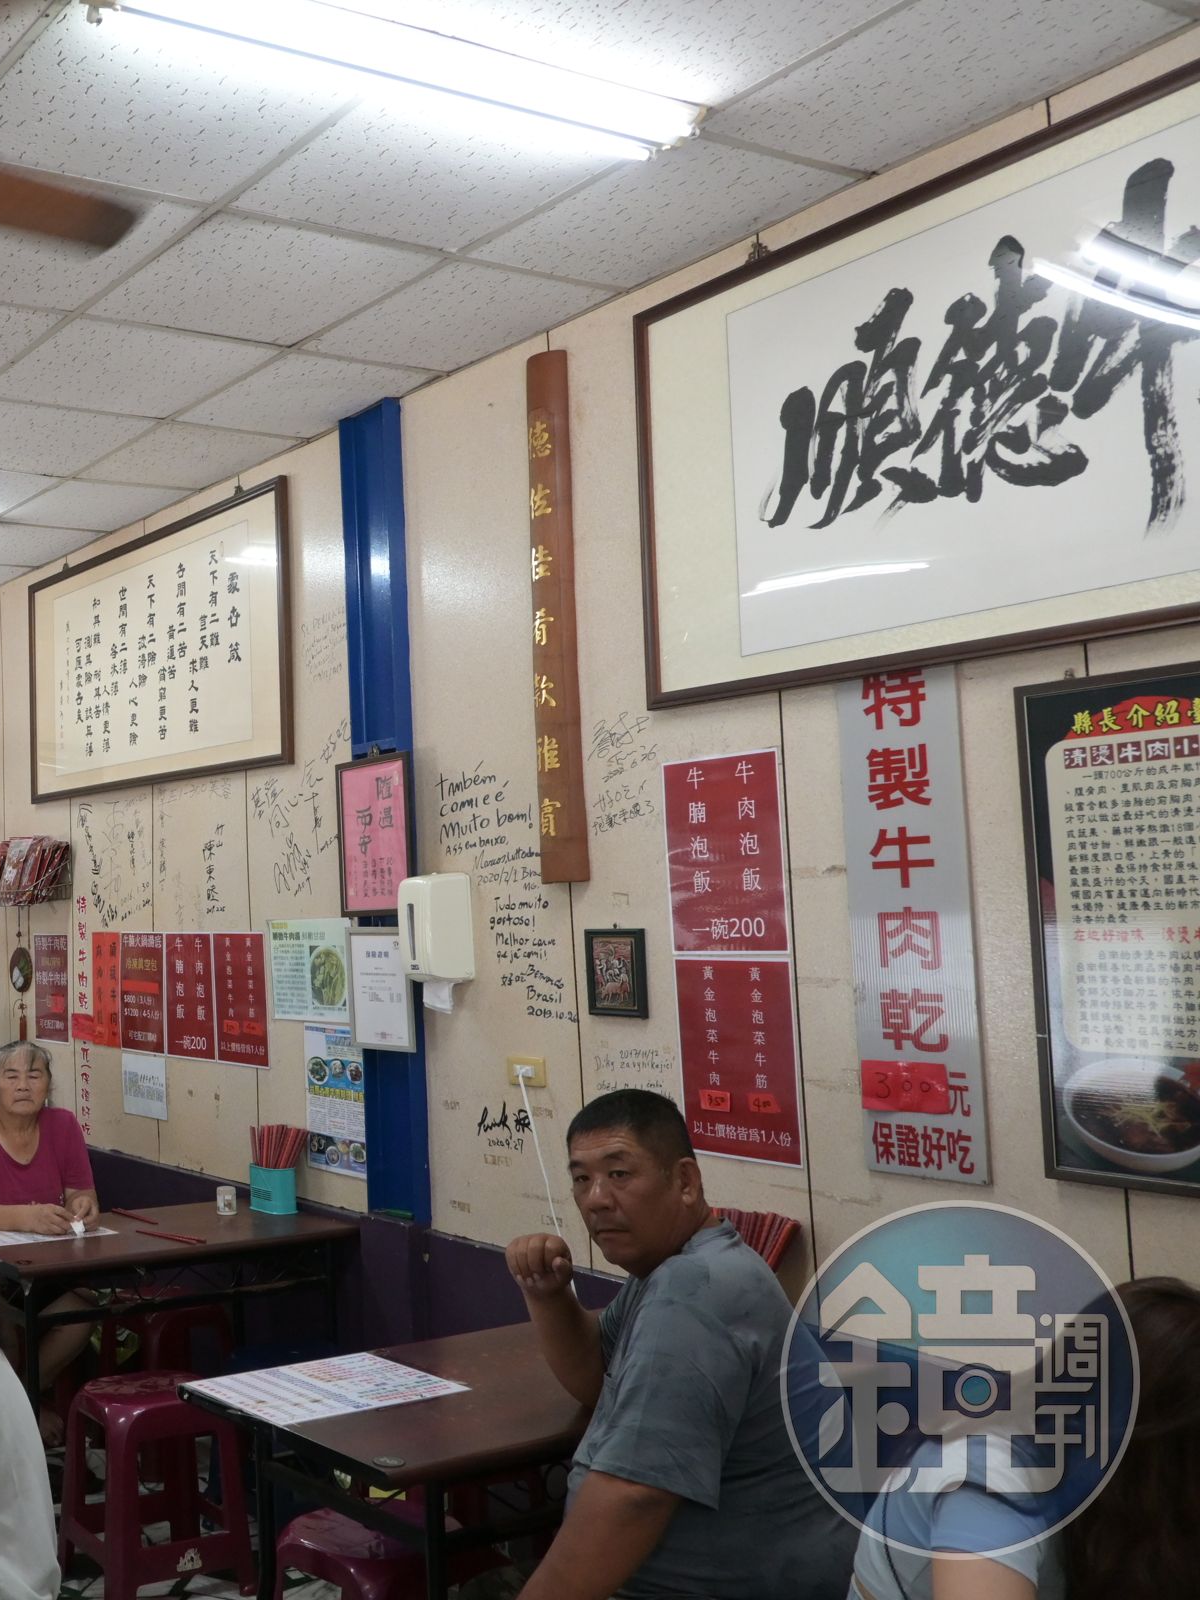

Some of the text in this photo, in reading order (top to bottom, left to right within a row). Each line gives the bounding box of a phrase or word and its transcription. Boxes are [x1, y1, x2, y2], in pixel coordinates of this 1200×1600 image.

[686, 766, 712, 894] 牛腩泡飯
[735, 760, 762, 892] 牛肉泡飯
[862, 667, 950, 1053] 特製牛肉乾
[692, 917, 766, 940] 一碗200
[175, 937, 185, 1020] 牛腩泡飯
[194, 937, 206, 1021] 牛肉泡飯
[527, 984, 562, 1004] Brasil
[175, 1035, 207, 1051] 一碗200
[701, 966, 720, 1086] 黃金泡菜牛肉
[749, 967, 768, 1089] 黃金泡菜牛筋
[872, 1121, 975, 1176] 保證好吃
